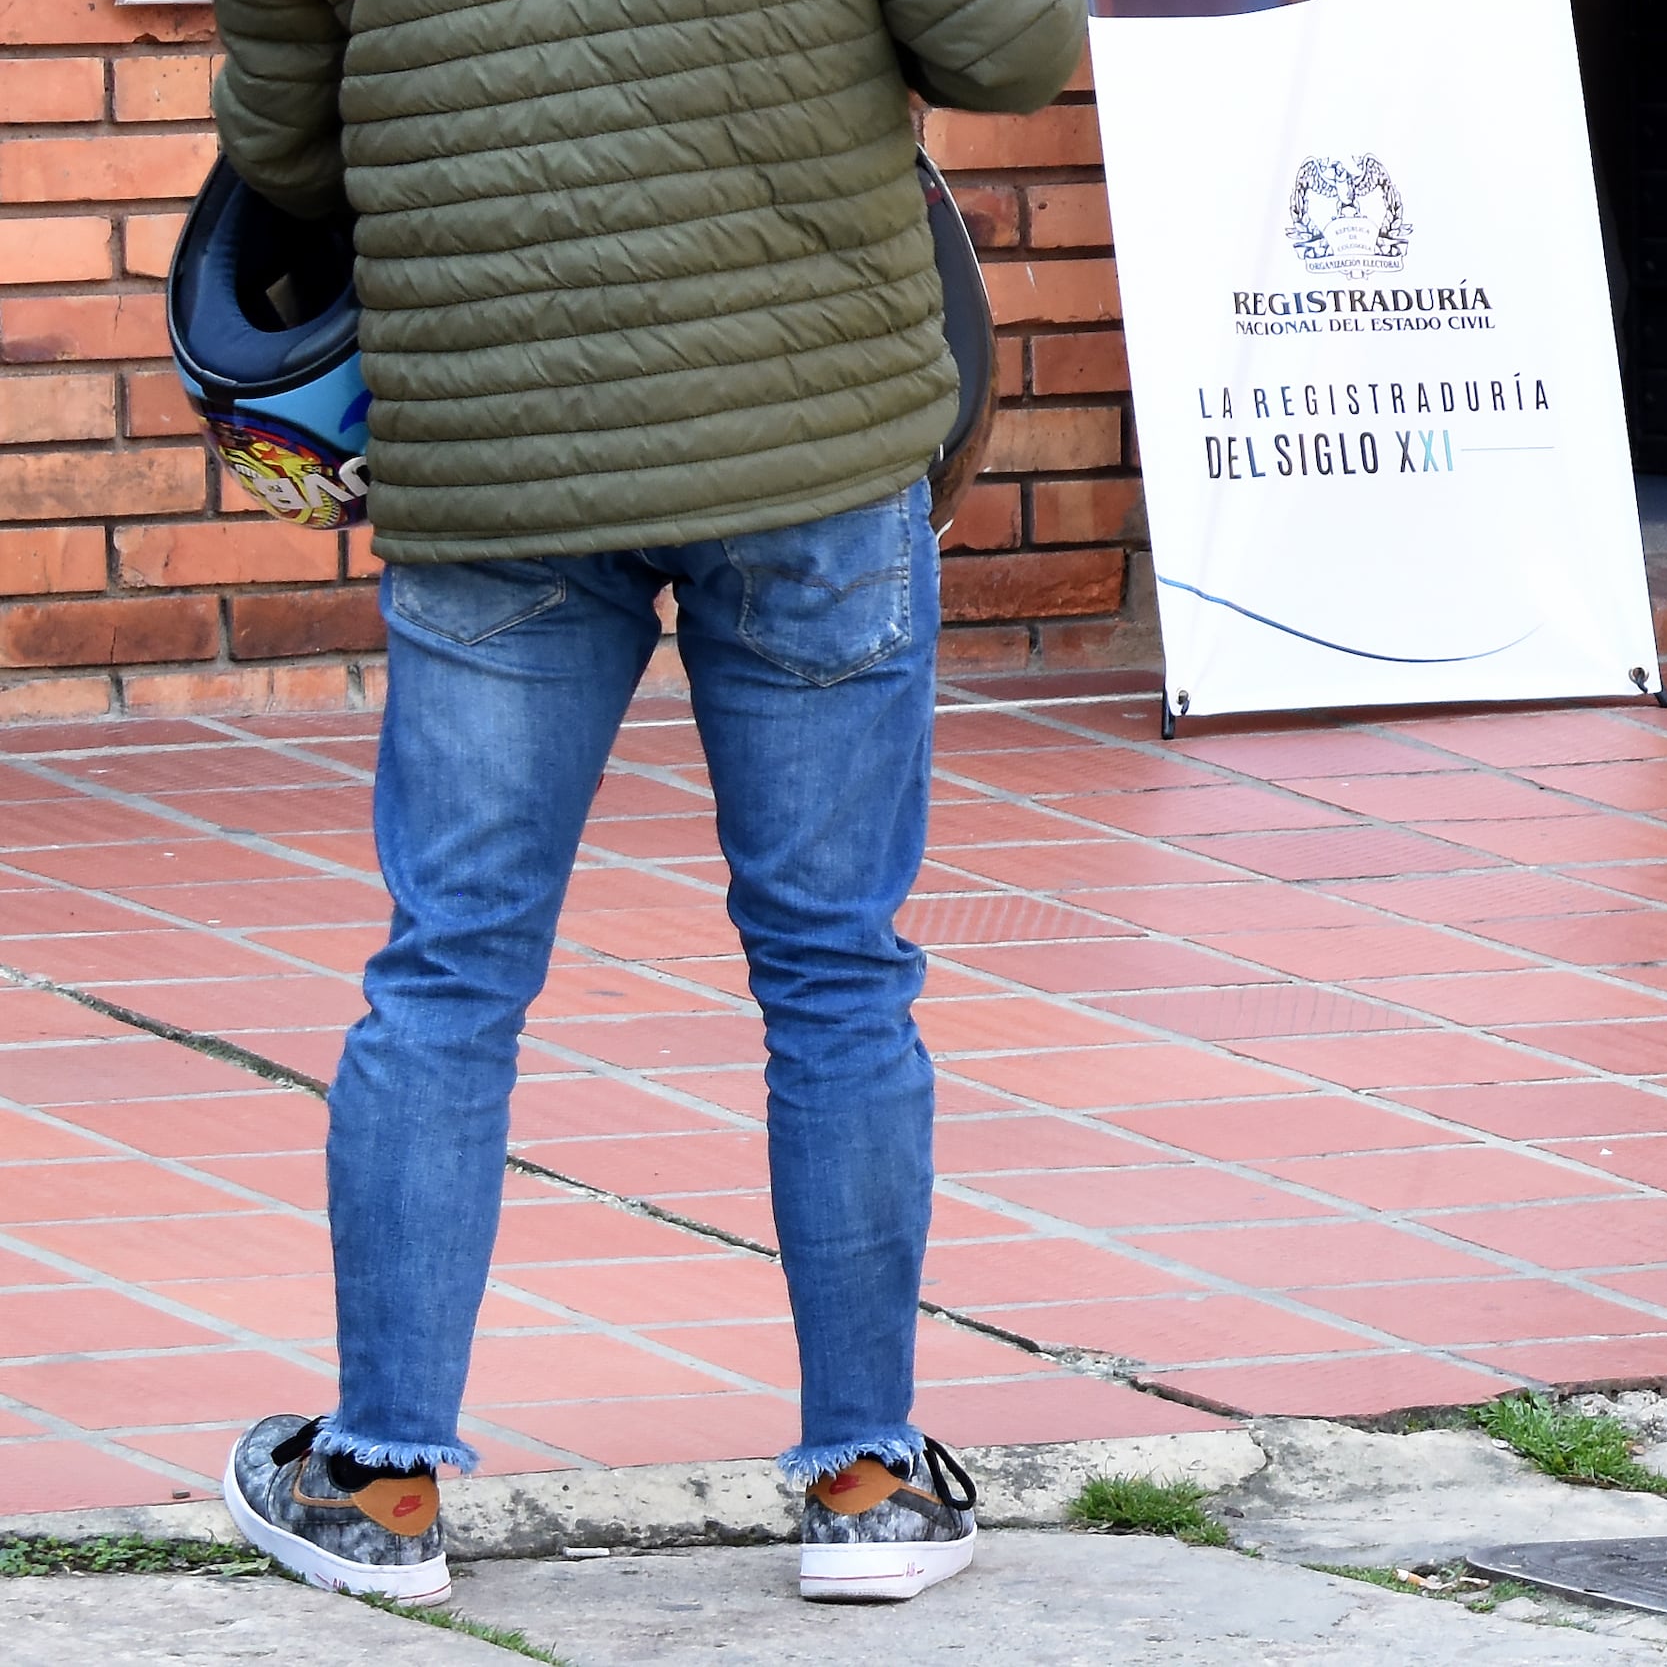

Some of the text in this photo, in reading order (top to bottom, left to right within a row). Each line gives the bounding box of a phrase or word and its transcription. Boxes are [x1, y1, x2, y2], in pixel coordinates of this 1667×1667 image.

[1232, 279, 1493, 316] REGISTRADURÍA
[1235, 316, 1496, 335] NACIONAL DEL ESTADO CIVIL
[1199, 372, 1550, 419] LA REGISTRADURÍA
[1205, 429, 1455, 480] DEL SIGLO XXI
